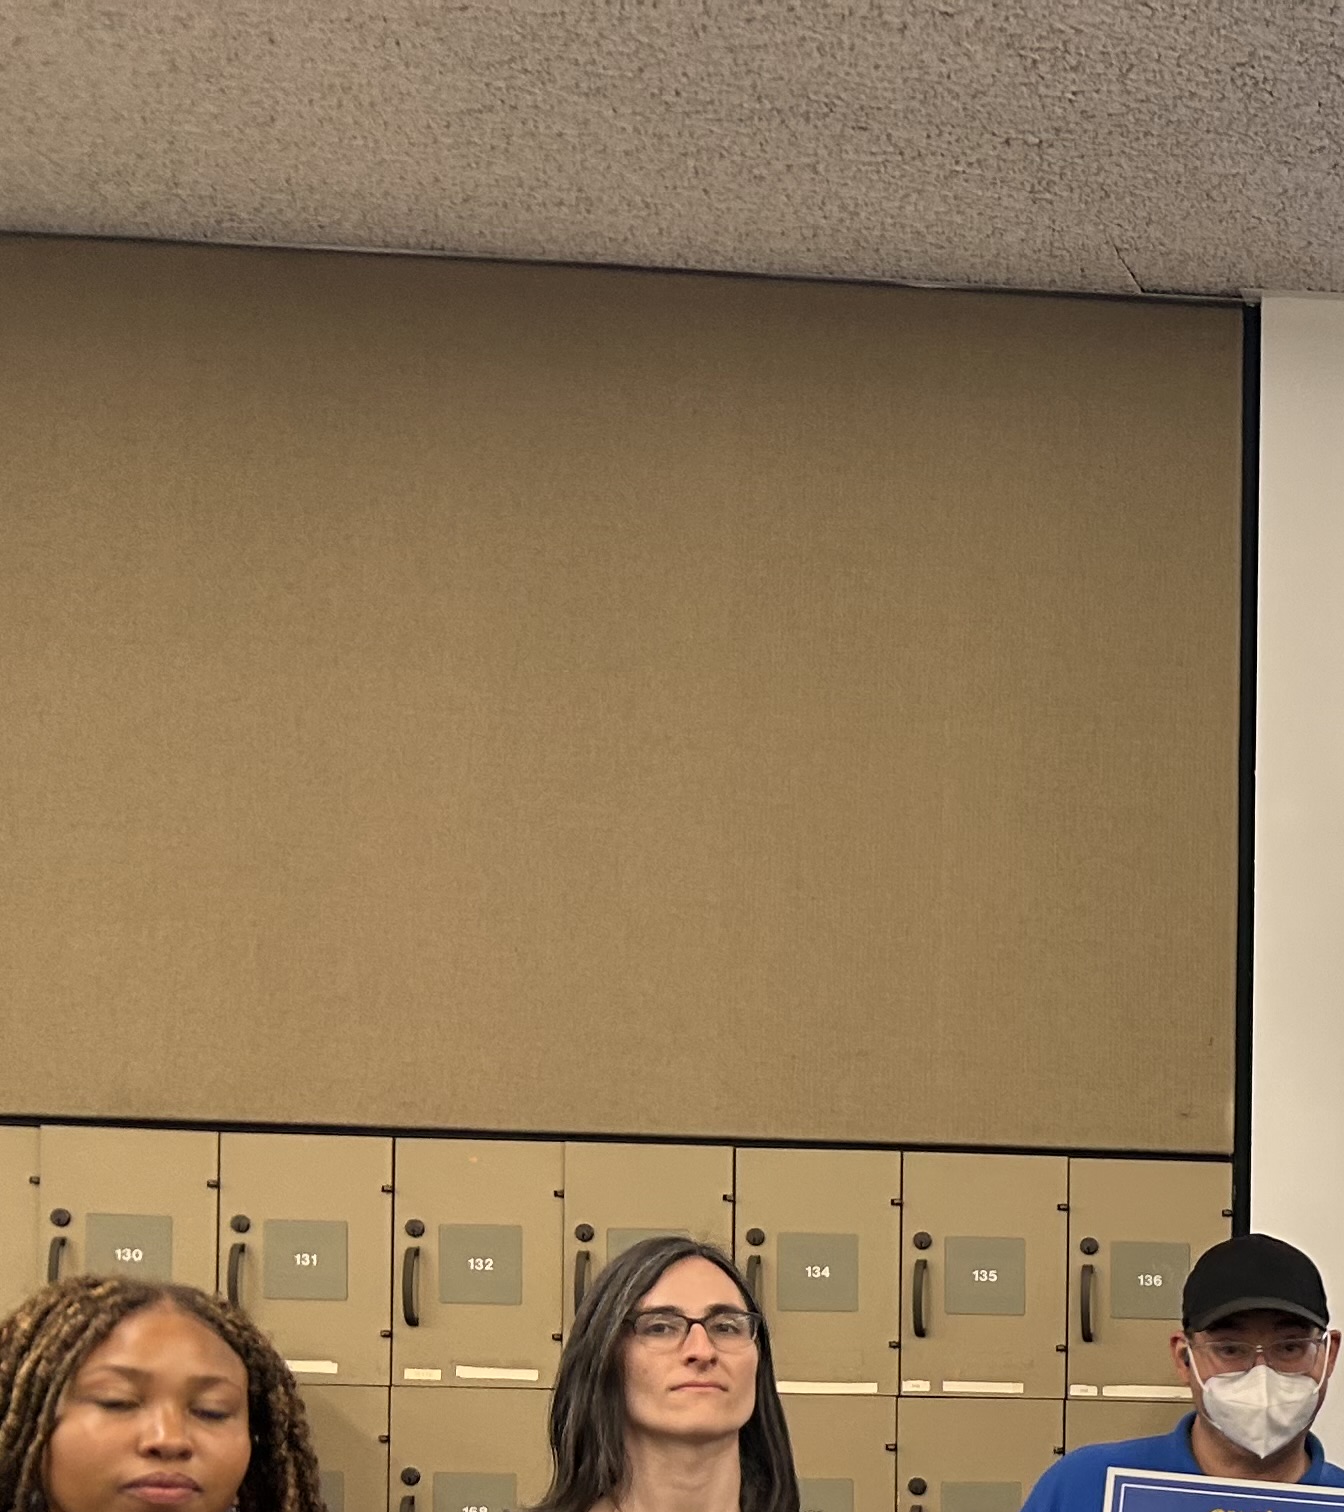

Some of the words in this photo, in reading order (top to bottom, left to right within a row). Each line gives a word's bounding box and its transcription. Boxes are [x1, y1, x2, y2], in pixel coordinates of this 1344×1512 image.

[114, 1248, 143, 1262] 130
[294, 1254, 318, 1266] 131
[467, 1258, 494, 1271] 132
[805, 1266, 831, 1278] 134
[972, 1270, 998, 1282] 135
[1138, 1274, 1163, 1287] 136
